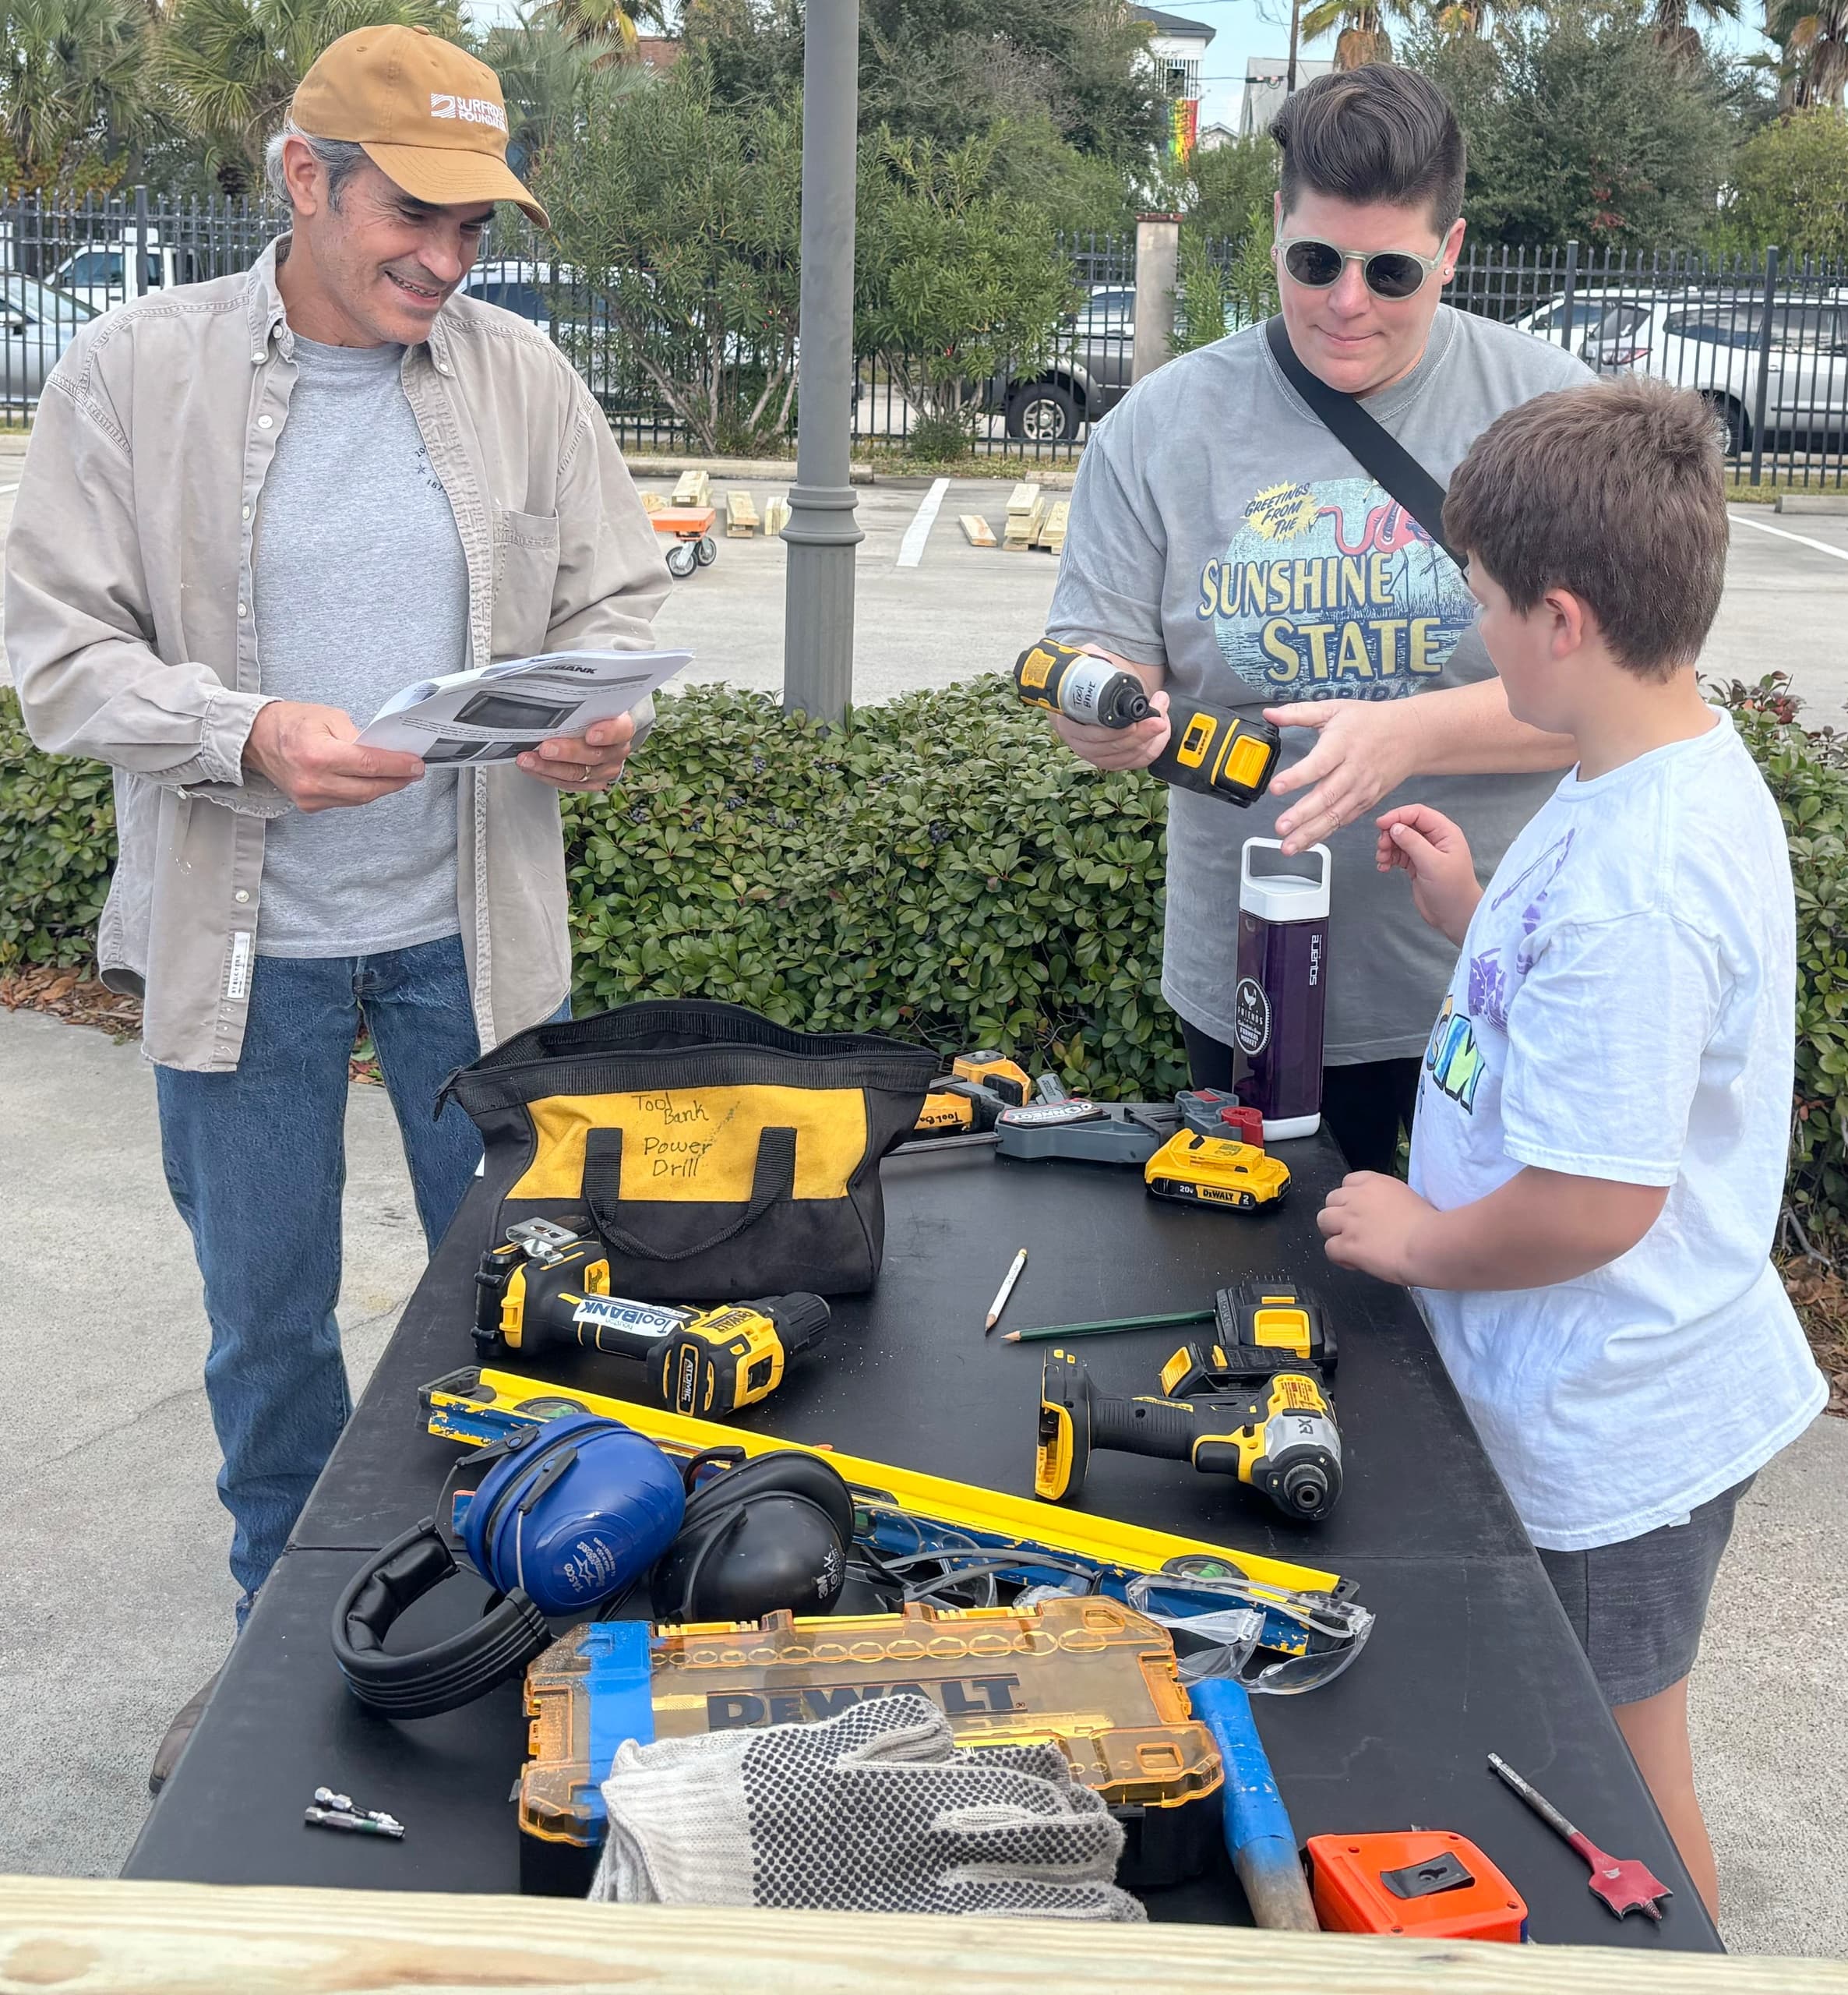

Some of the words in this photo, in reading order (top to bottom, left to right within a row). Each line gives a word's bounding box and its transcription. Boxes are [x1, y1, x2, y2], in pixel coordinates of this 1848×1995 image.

[1245, 482, 1310, 518] GREETINGS
[1261, 500, 1303, 526] FROM
[1273, 517, 1300, 539] THE
[1197, 553, 1395, 621] SUNSHINE
[1259, 616, 1443, 687] STATE
[631, 1092, 672, 1112] Tool
[664, 1100, 710, 1125] Bank
[644, 1136, 713, 1156] Power
[653, 1158, 700, 1178] Drill
[580, 1301, 672, 1334] ToolBANK
[1297, 1418, 1314, 1435] XR
[563, 1562, 584, 1593] TASCO
[816, 1573, 828, 1599] 3M
